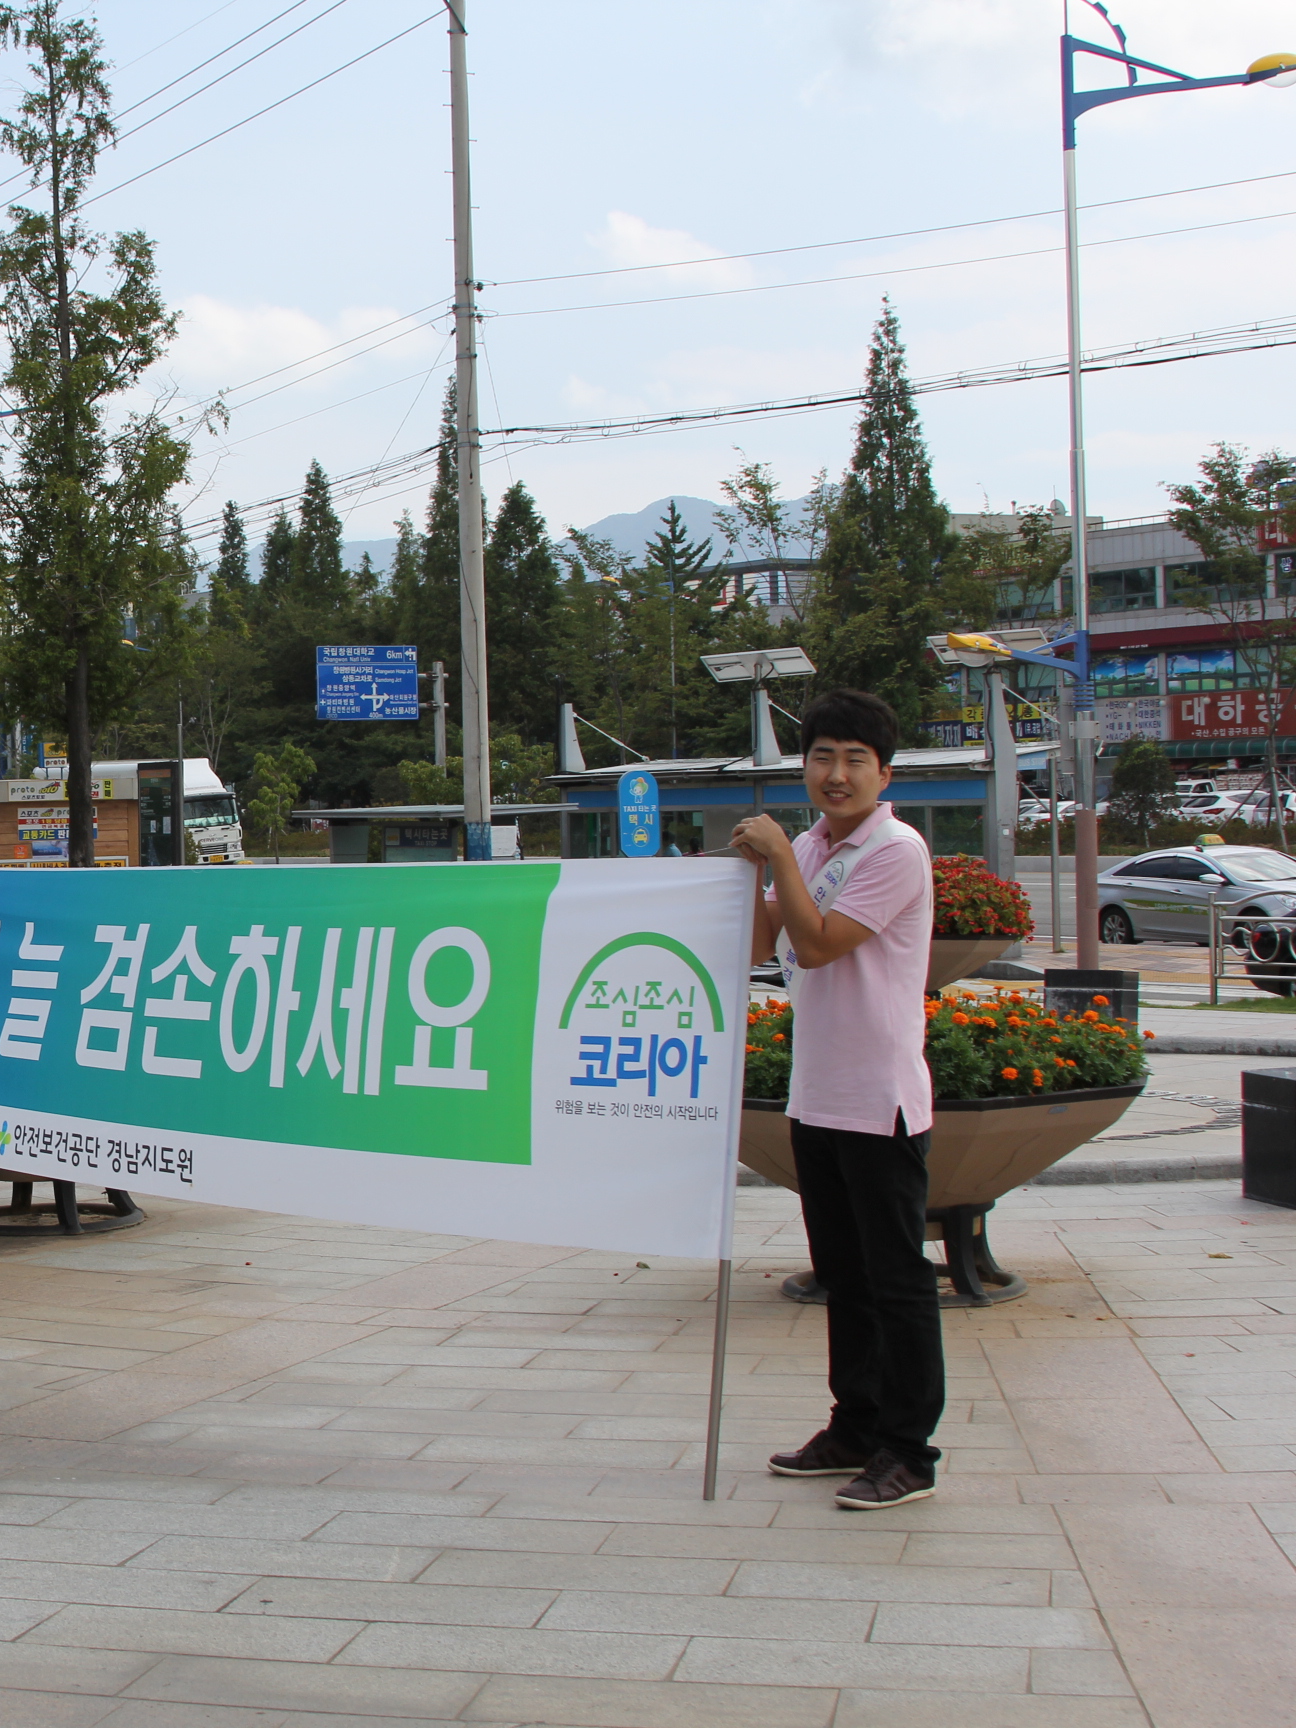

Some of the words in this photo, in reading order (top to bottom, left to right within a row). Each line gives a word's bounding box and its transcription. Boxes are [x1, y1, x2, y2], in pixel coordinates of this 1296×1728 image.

[323, 647, 375, 656] 국립창원대학교
[386, 650, 403, 659] 6km
[1181, 692, 1296, 726] 대하공
[10, 786, 35, 795] proto
[19, 810, 39, 818] 스포츠
[628, 813, 653, 826] 택시
[22, 829, 56, 840] 교통카드
[405, 827, 448, 841] 택시타는곳
[75, 923, 491, 1096] 겸손하세요
[585, 980, 696, 1029] 조심조심
[570, 1034, 708, 1099] 코리아
[555, 1100, 584, 1116] 위험을
[586, 1101, 606, 1116] 보는
[610, 1102, 630, 1118] 것이
[633, 1103, 664, 1119] 안전의
[666, 1104, 719, 1121] 시작입니다
[13, 1124, 101, 1169] 안전보건공단
[107, 1138, 193, 1184] 경남지도원
